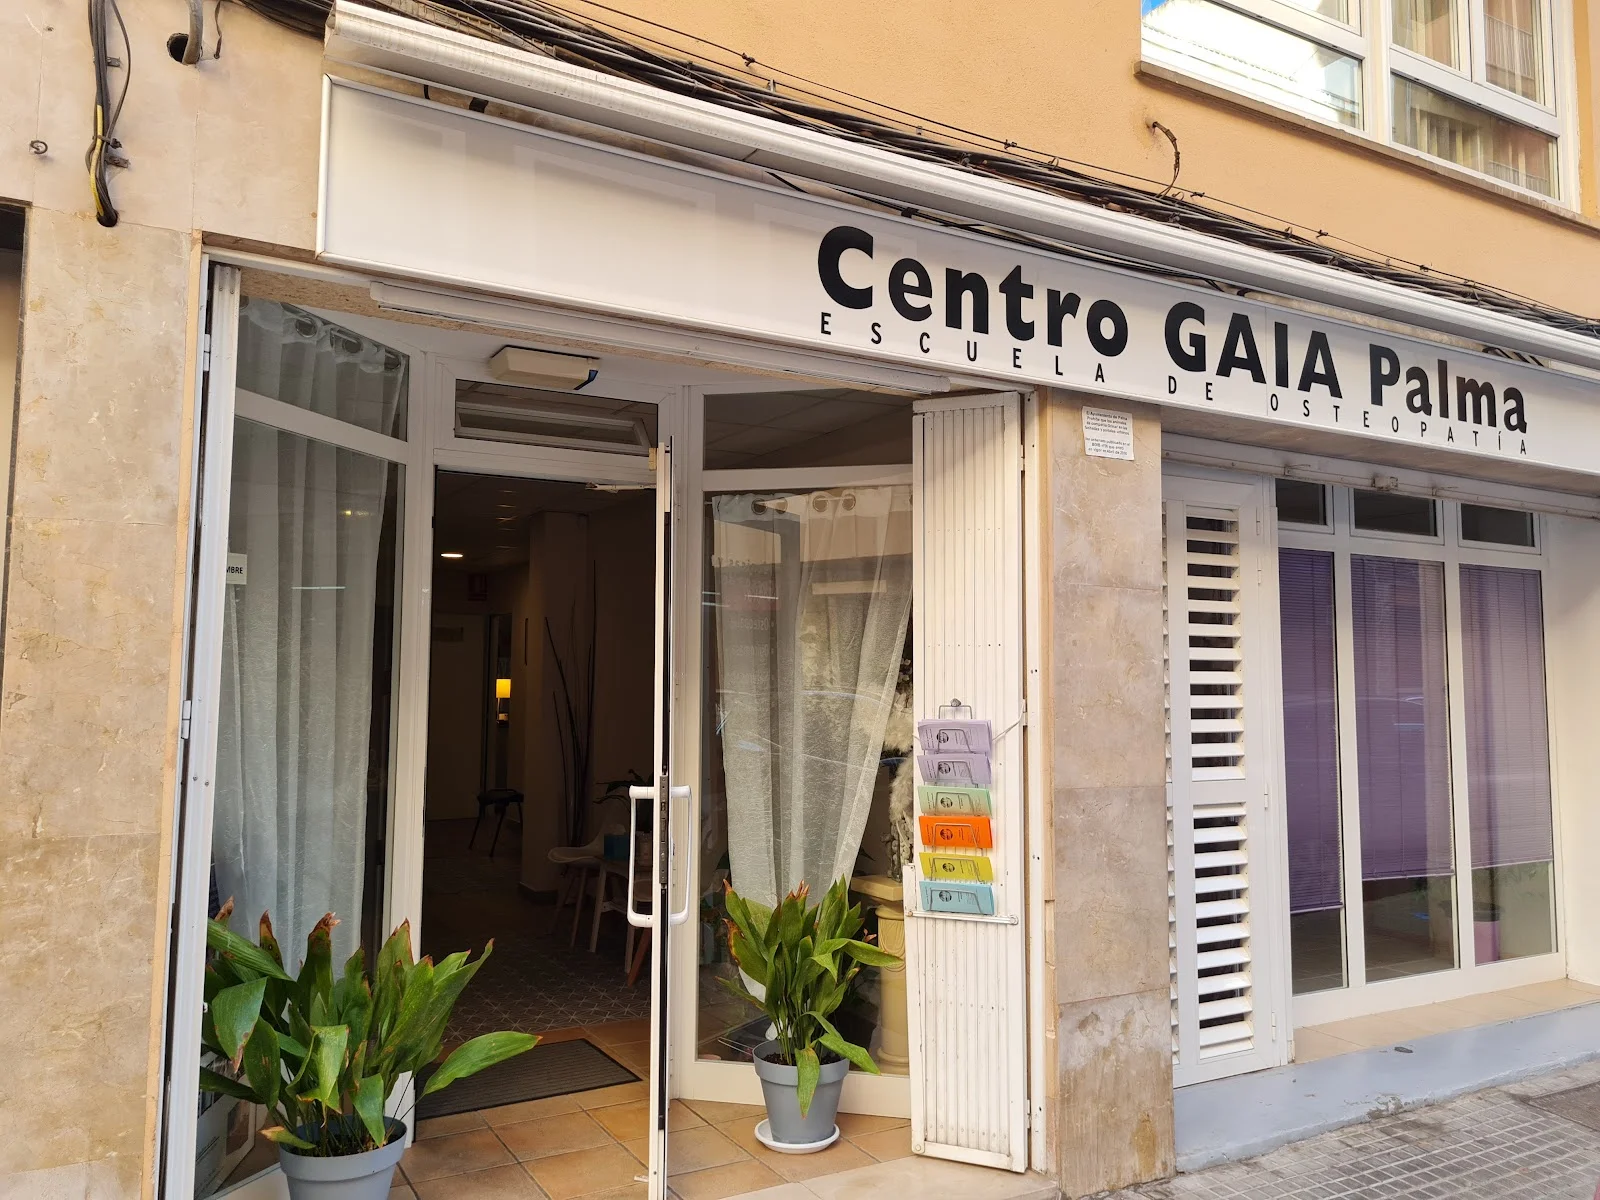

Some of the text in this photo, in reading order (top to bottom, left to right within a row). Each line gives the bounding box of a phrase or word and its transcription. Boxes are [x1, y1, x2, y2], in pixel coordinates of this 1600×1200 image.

[818, 226, 1528, 434] Centro GAIA Palma
[820, 312, 1527, 455] ESCUELA DE OSTEOPATÍA
